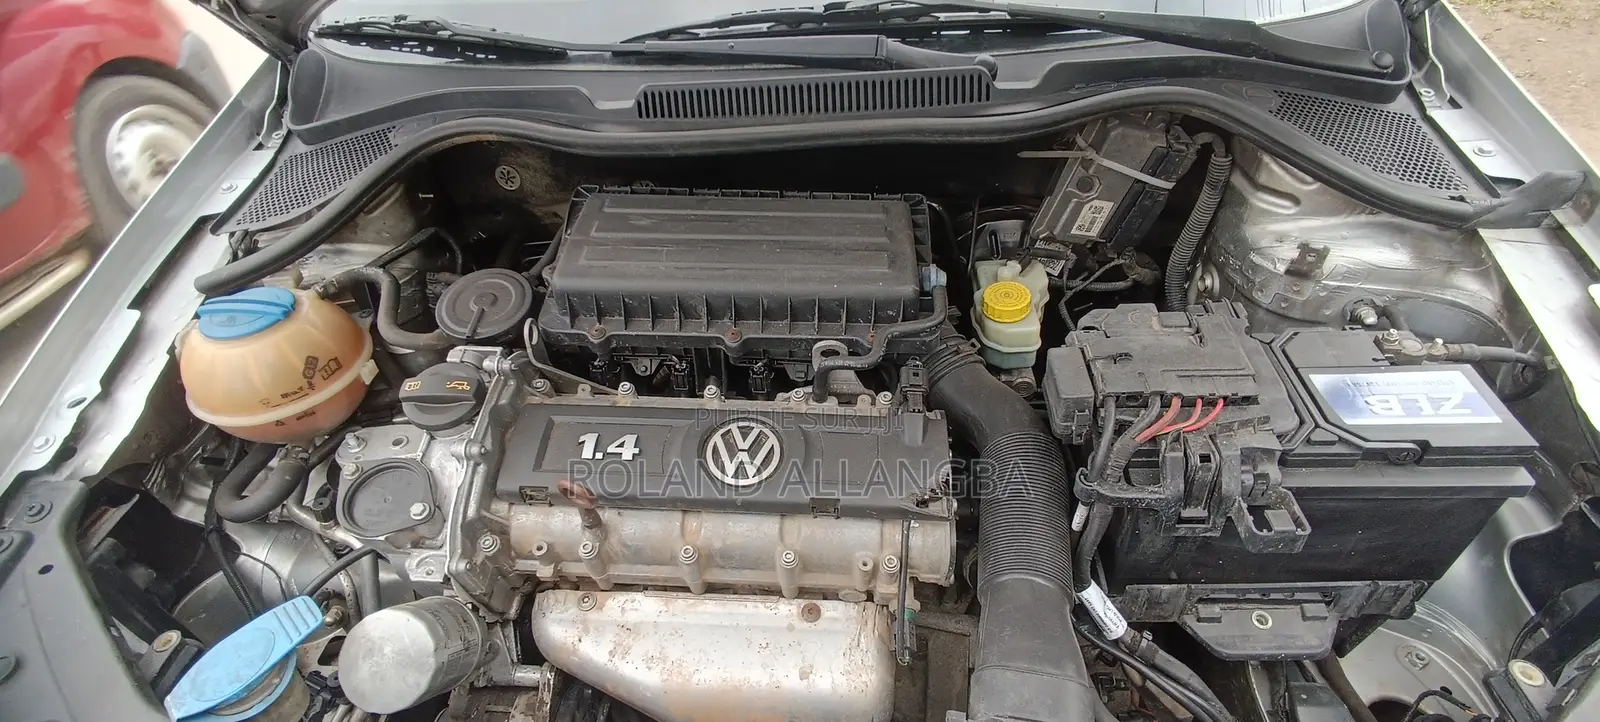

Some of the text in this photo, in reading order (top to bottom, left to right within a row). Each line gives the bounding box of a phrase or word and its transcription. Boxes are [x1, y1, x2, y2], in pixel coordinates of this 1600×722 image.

[1364, 393, 1472, 416] ZLB
[577, 432, 641, 461] 1.4
[705, 421, 781, 487] VW
